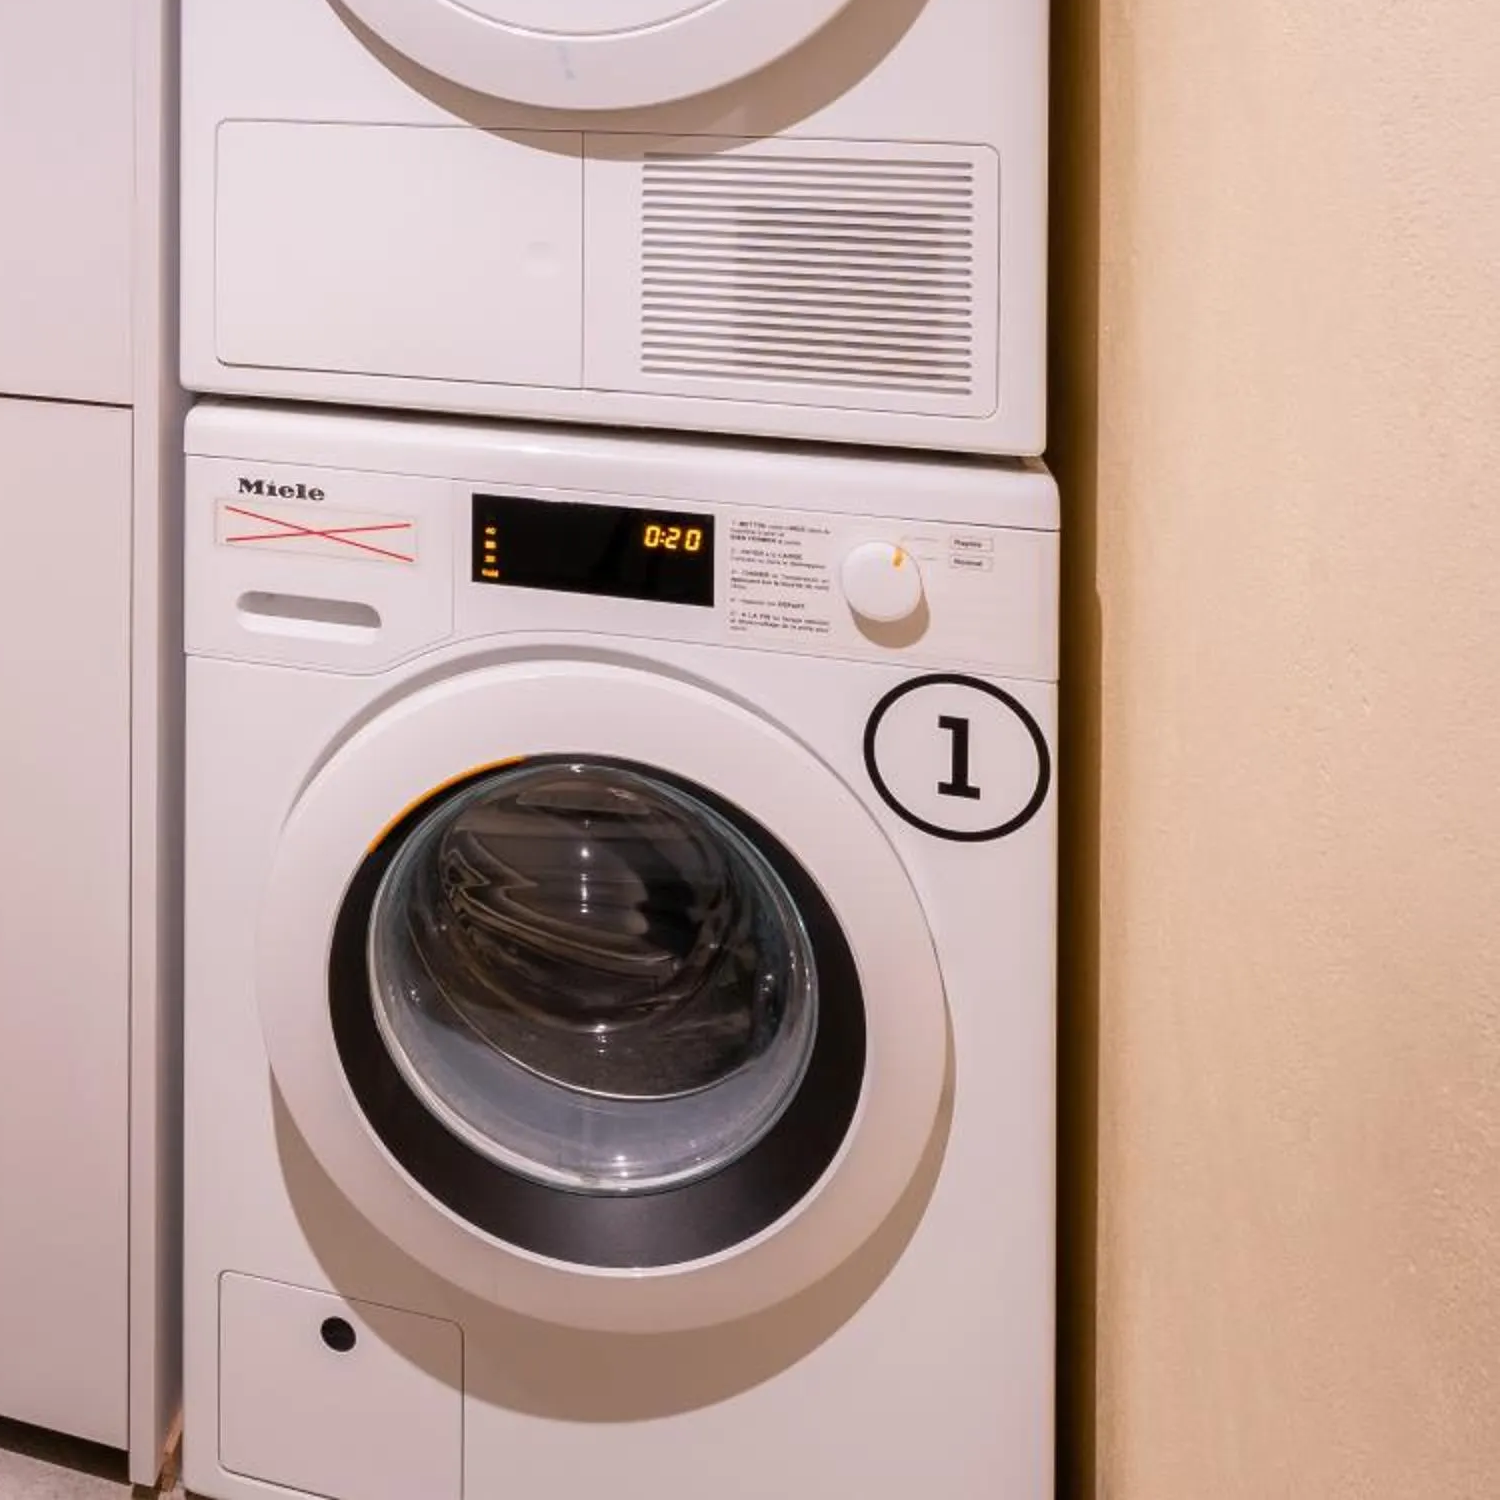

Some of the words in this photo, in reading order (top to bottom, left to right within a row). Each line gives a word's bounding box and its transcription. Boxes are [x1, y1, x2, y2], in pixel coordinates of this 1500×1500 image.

[237, 476, 326, 501] Miele
[643, 524, 702, 552] 0:20
[937, 714, 982, 801] 1
